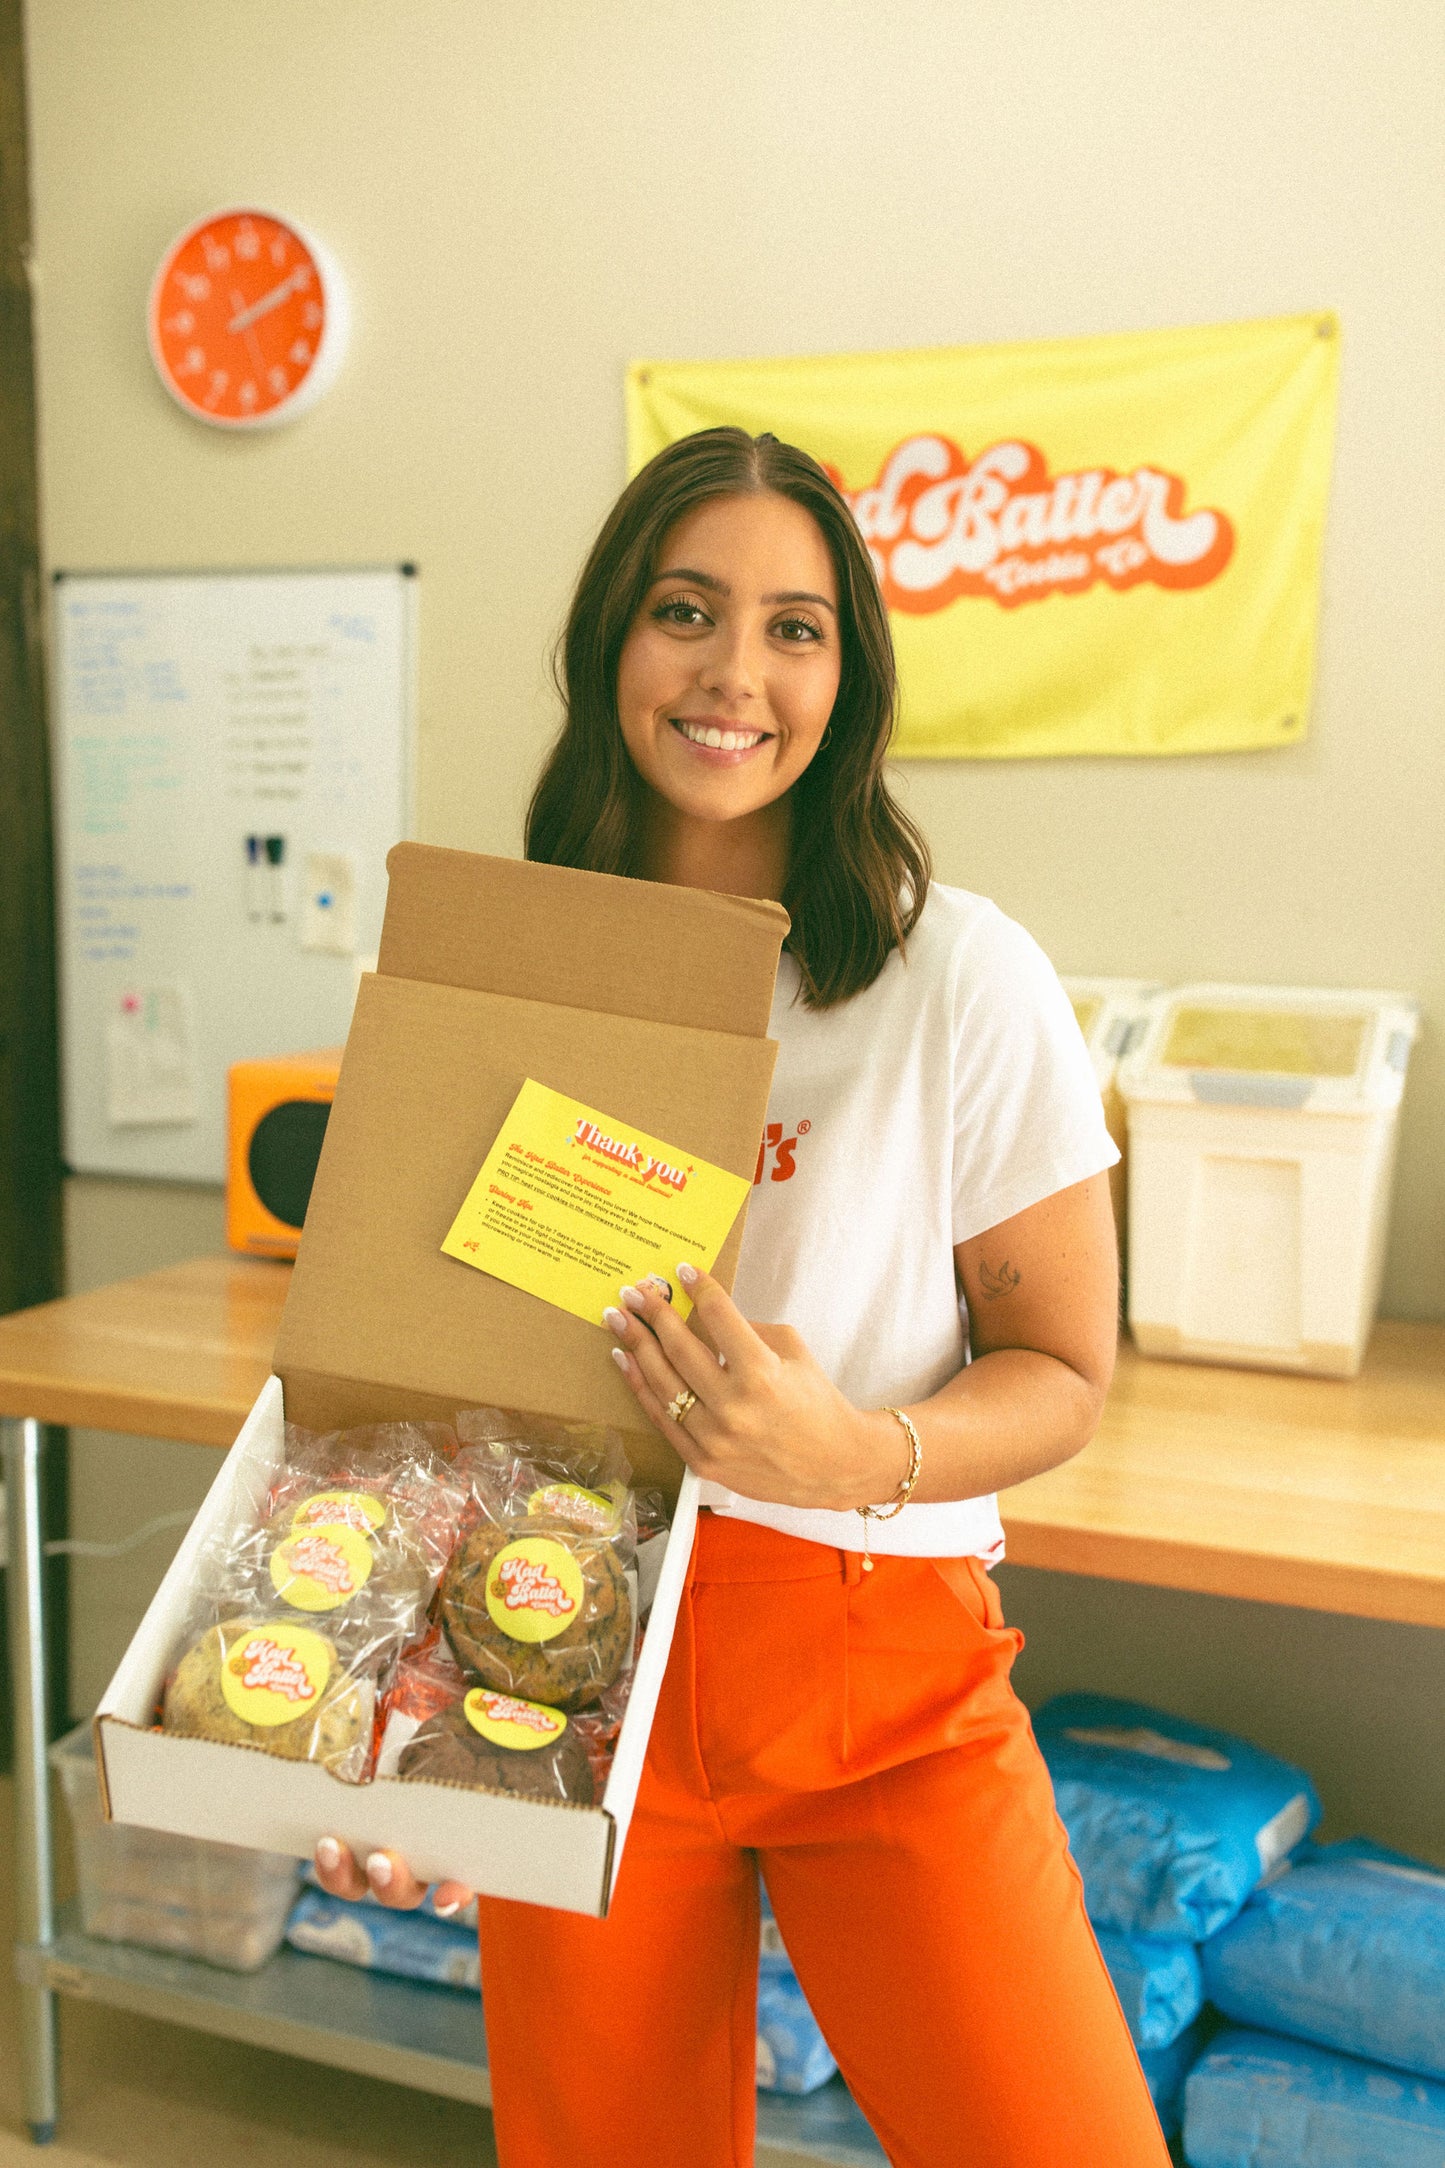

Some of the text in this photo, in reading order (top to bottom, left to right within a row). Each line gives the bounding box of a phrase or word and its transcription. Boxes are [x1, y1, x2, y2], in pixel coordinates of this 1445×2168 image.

[890, 440, 1220, 592] Batter
[575, 1117, 686, 1190] Thank you
